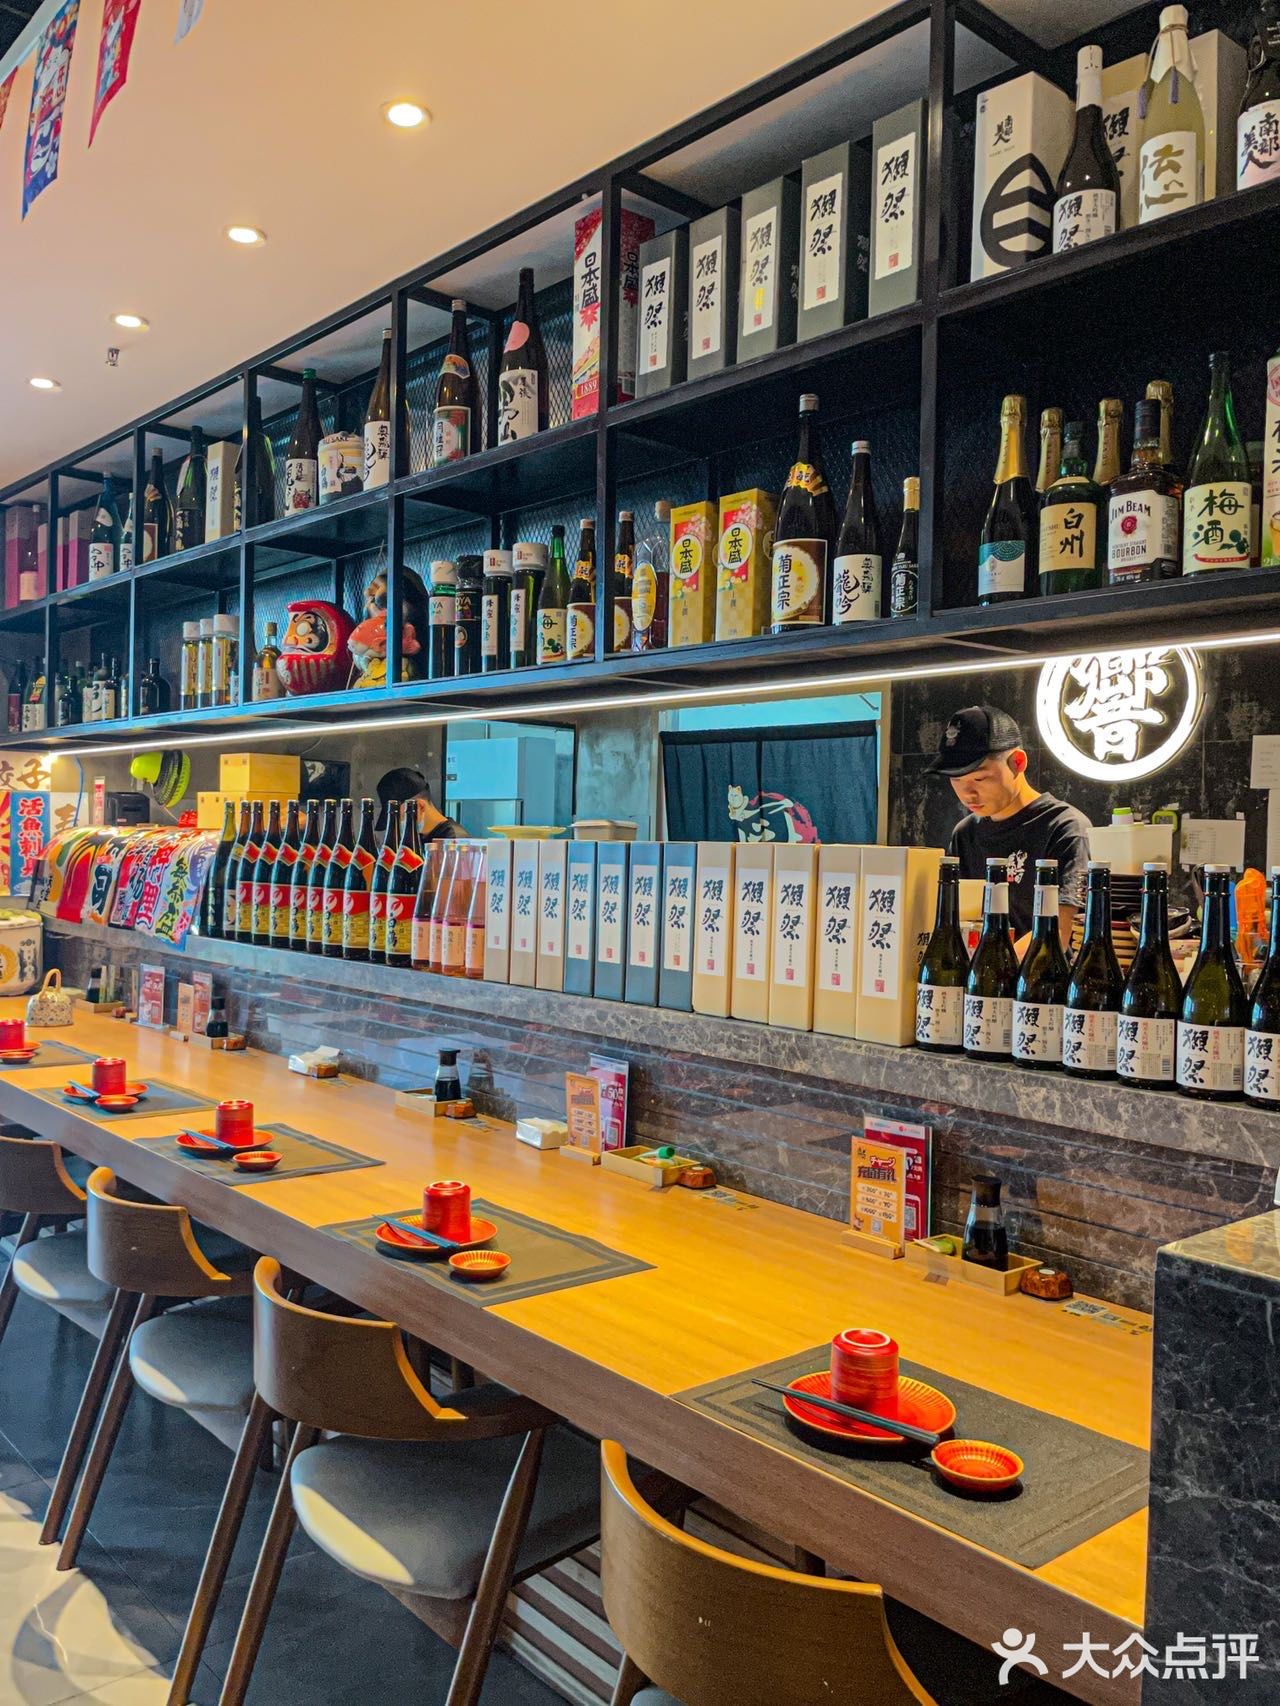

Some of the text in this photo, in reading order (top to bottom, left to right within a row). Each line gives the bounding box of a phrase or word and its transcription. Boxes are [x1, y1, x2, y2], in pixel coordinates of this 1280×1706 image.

[581, 251, 600, 308] 日本盛
[580, 379, 597, 398] 1889
[1110, 500, 1151, 524] JIM BEAM
[1192, 488, 1245, 548] 梅酒
[728, 527, 744, 564] 日本盛
[1059, 507, 1084, 558] 白州
[679, 537, 693, 574] 日本盛
[1112, 544, 1147, 559] BOURBON
[777, 553, 792, 610] 菊正宗
